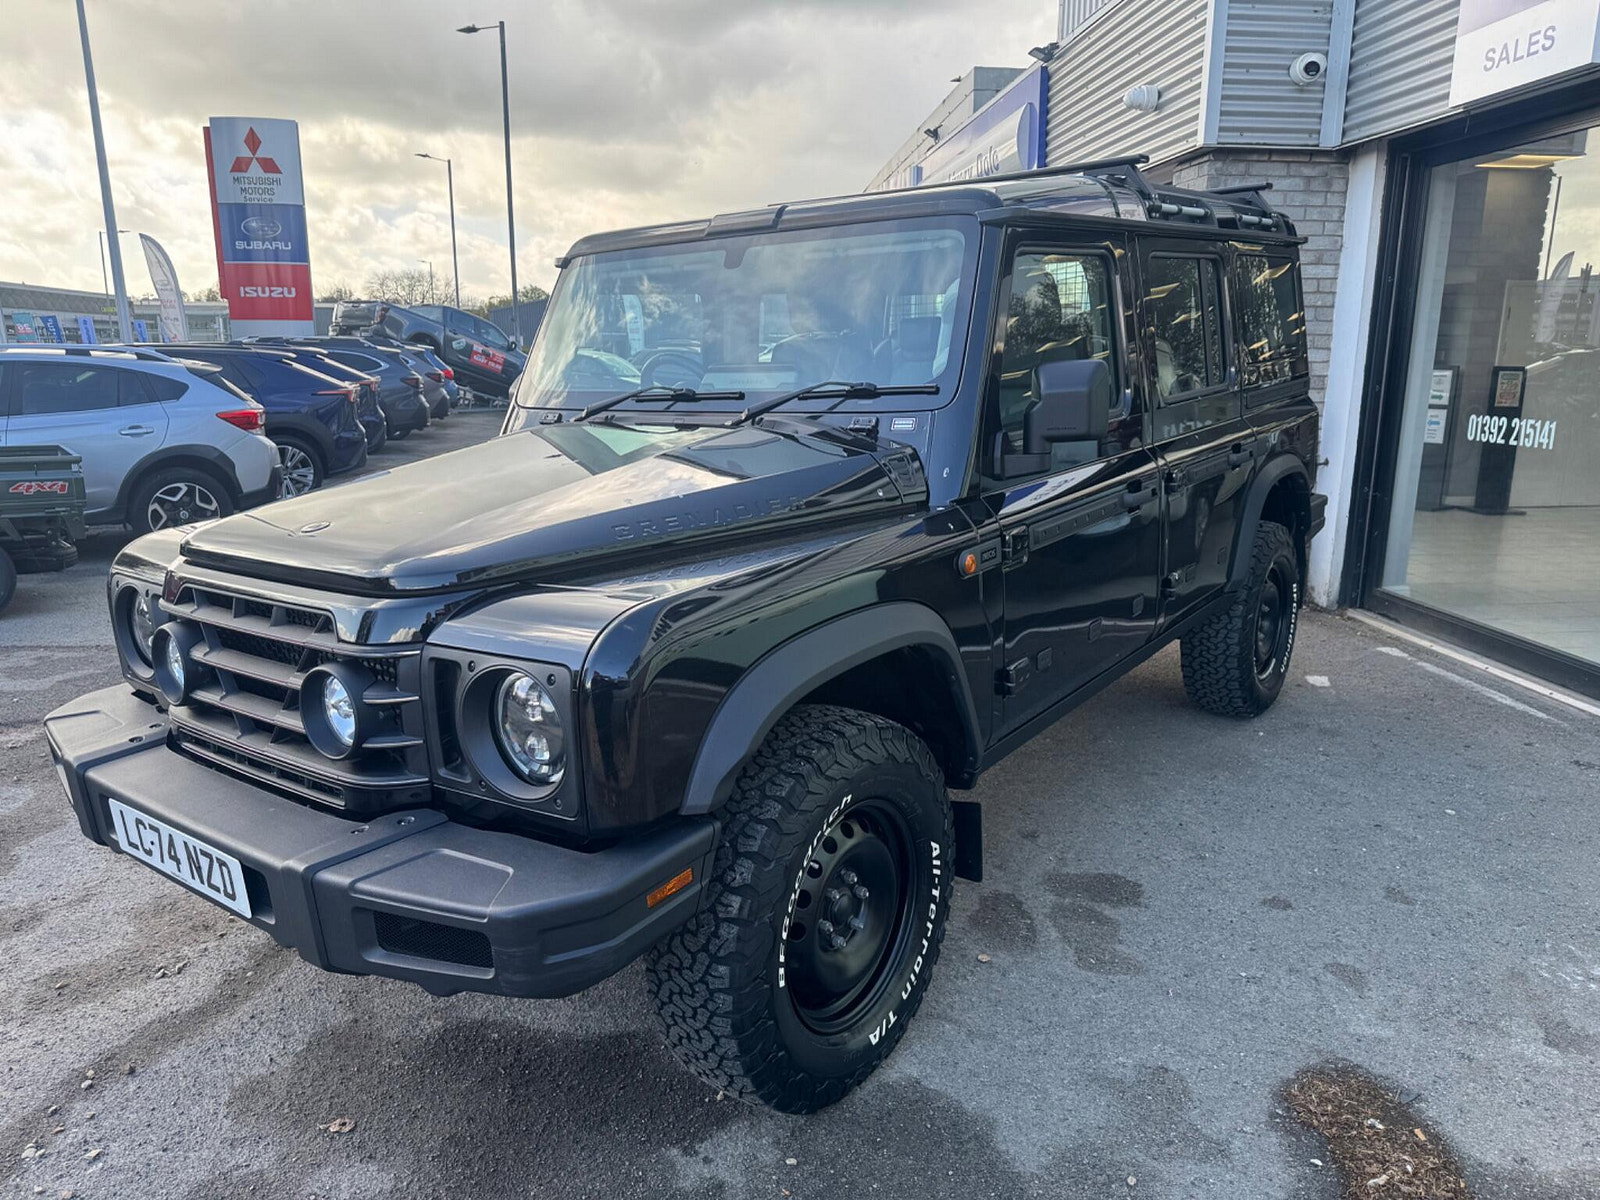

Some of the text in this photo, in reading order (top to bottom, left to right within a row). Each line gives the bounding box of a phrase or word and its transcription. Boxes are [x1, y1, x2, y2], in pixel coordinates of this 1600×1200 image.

[1483, 25, 1557, 72] SALES
[232, 176, 282, 187] MITSUBISHI
[240, 187, 276, 197] MOTORS
[243, 195, 274, 203] Service
[235, 240, 292, 251] SUBARU
[239, 286, 297, 298] ISUZU
[1467, 414, 1557, 450] 01392 215141
[119, 809, 237, 902] LC74 NZD
[868, 841, 942, 1046] All-Terrain T/A
